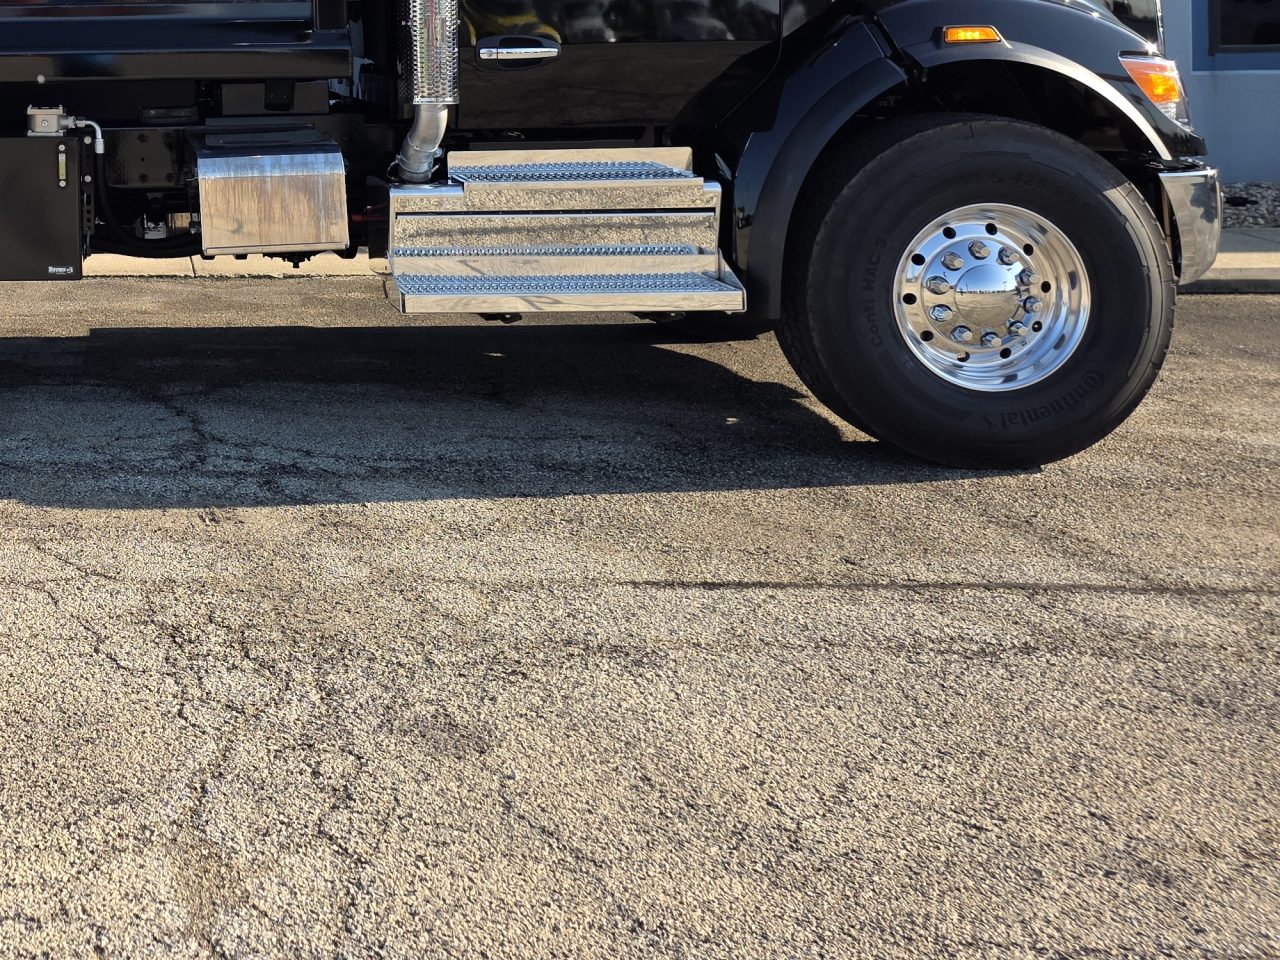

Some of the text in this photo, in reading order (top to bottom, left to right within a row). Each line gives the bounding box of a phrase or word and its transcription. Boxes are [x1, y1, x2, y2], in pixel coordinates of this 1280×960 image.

[861, 252, 881, 292] HAC
[861, 298, 883, 348] Conti
[1000, 369, 1105, 430] Continental
